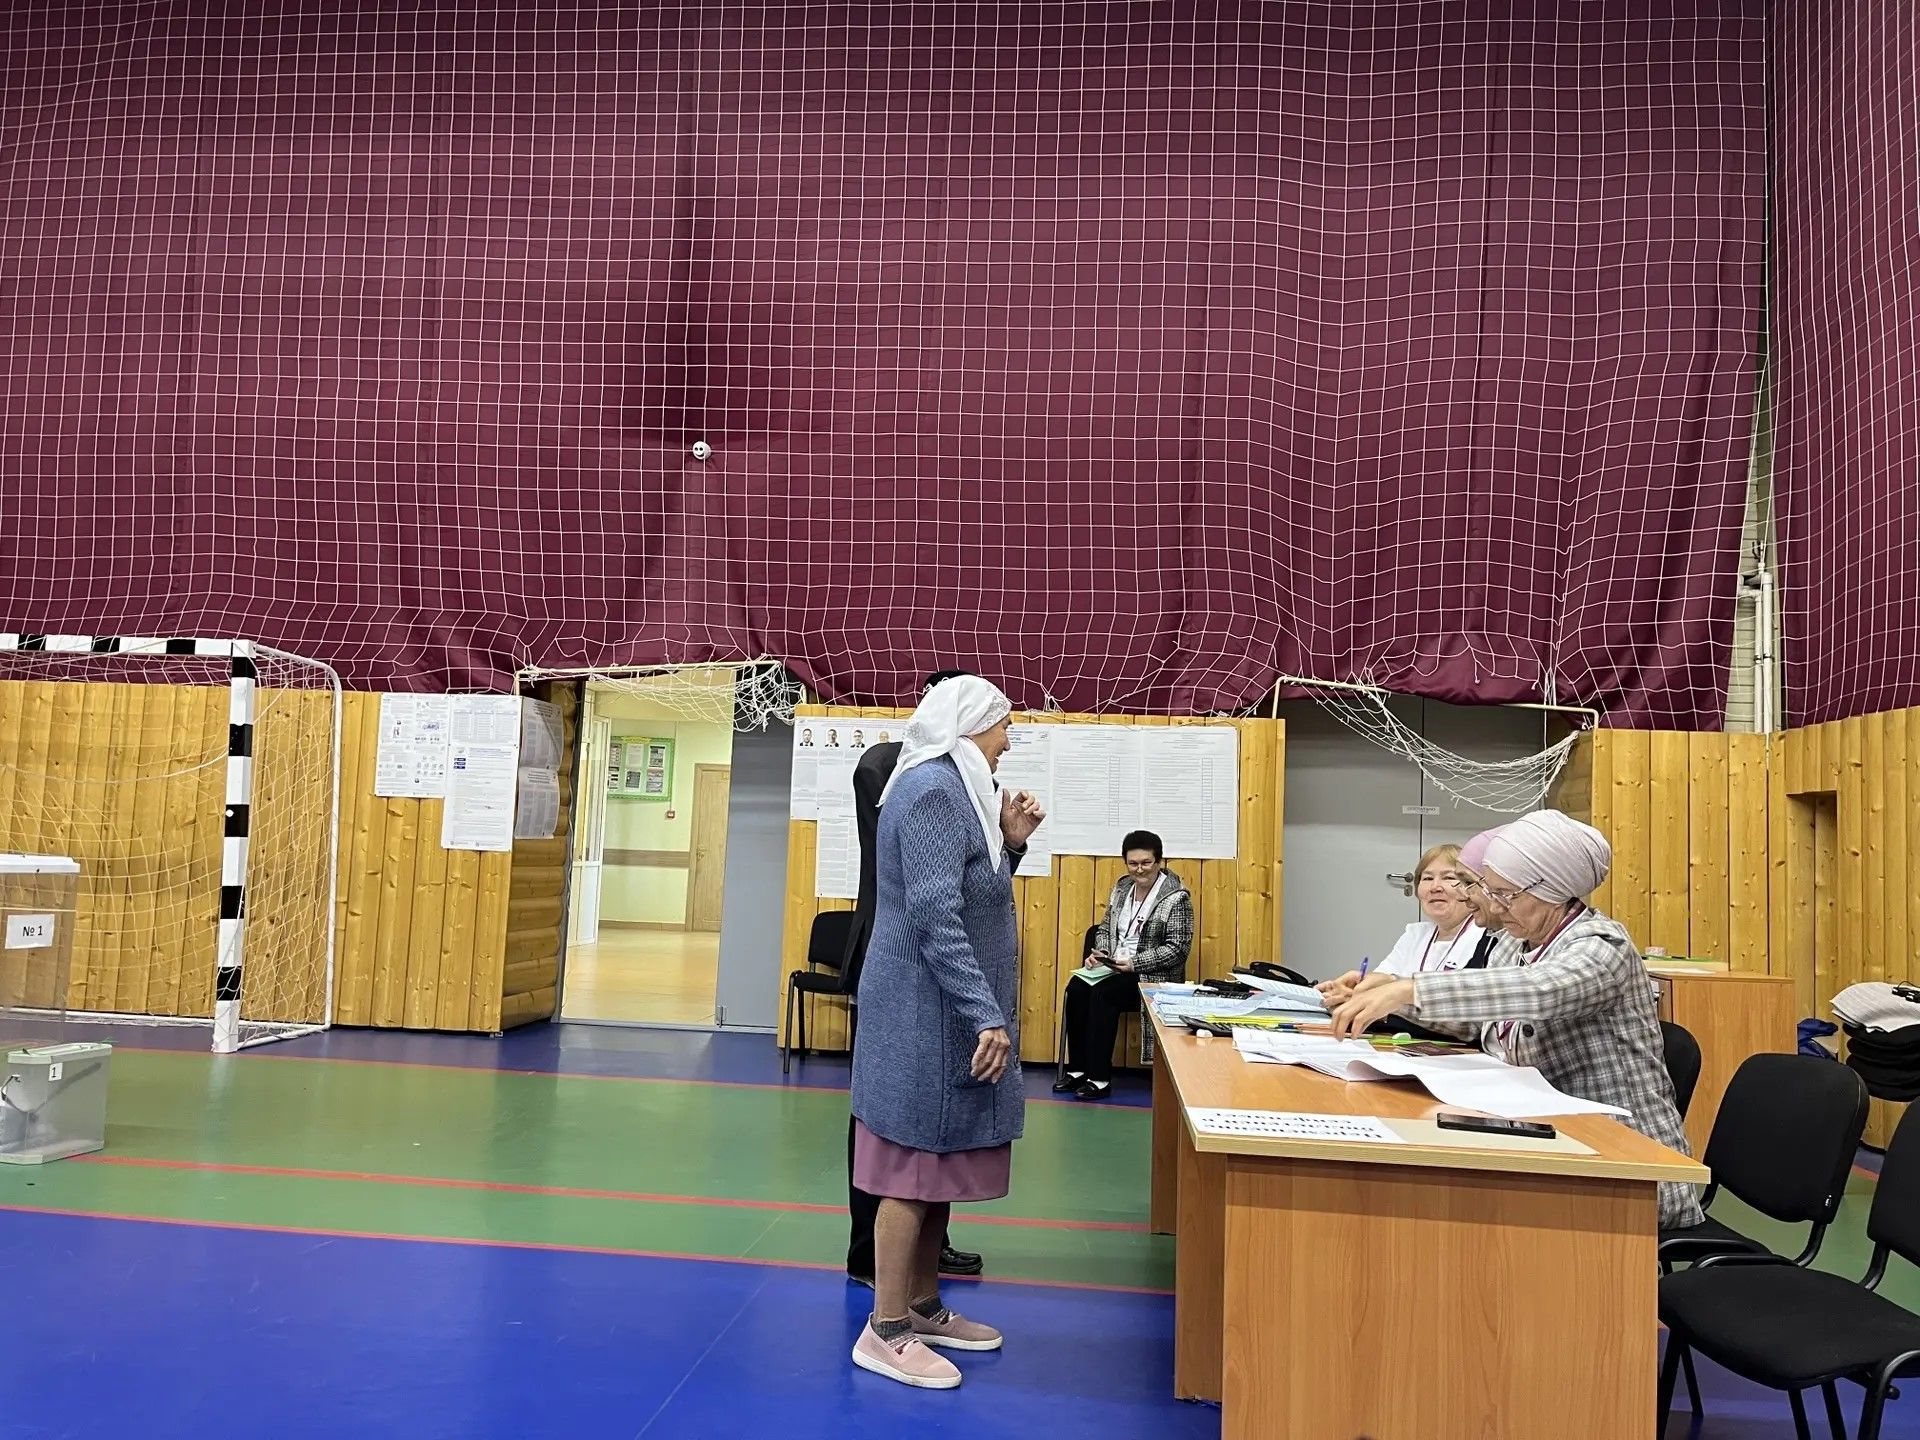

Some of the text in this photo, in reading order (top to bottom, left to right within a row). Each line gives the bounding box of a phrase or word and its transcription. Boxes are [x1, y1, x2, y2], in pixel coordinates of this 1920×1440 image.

[22, 925, 43, 937] № 1
[51, 1066, 57, 1078] 1
